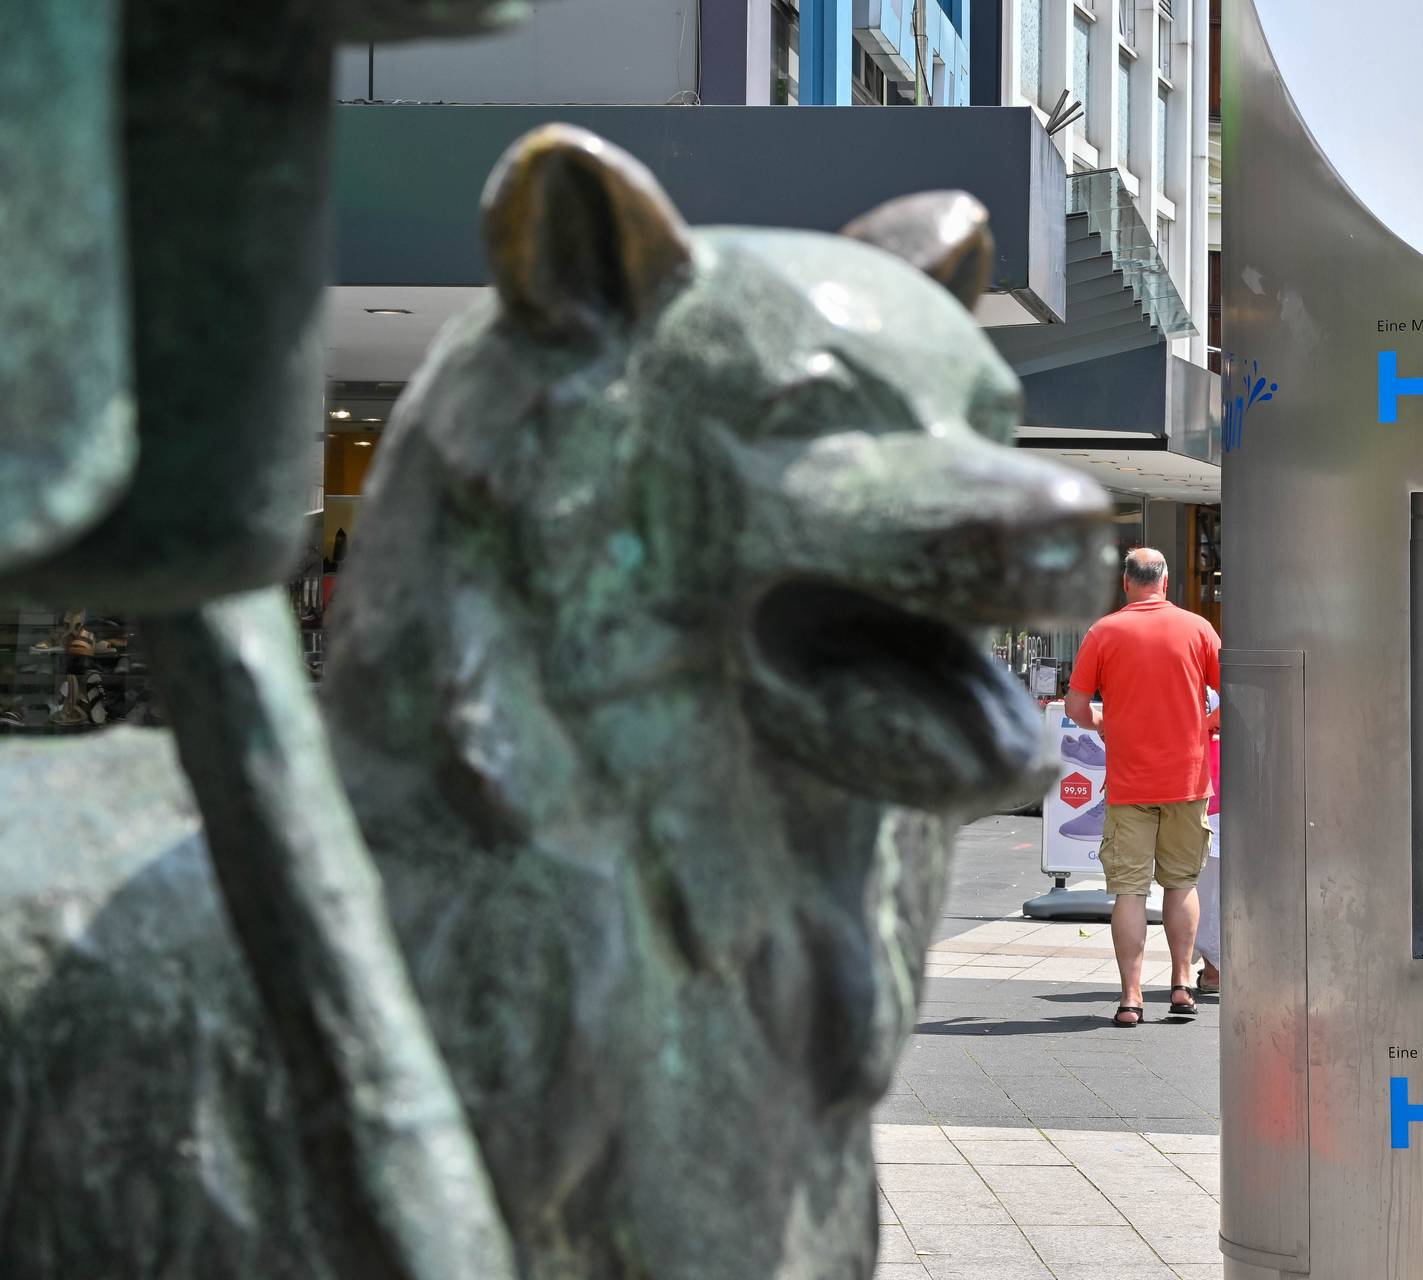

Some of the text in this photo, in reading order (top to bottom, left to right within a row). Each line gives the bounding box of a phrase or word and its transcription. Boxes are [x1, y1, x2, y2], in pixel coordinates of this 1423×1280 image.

[1377, 319, 1407, 333] Eine
[1064, 786, 1088, 796] 99,95
[1387, 1046, 1418, 1059] Eine
